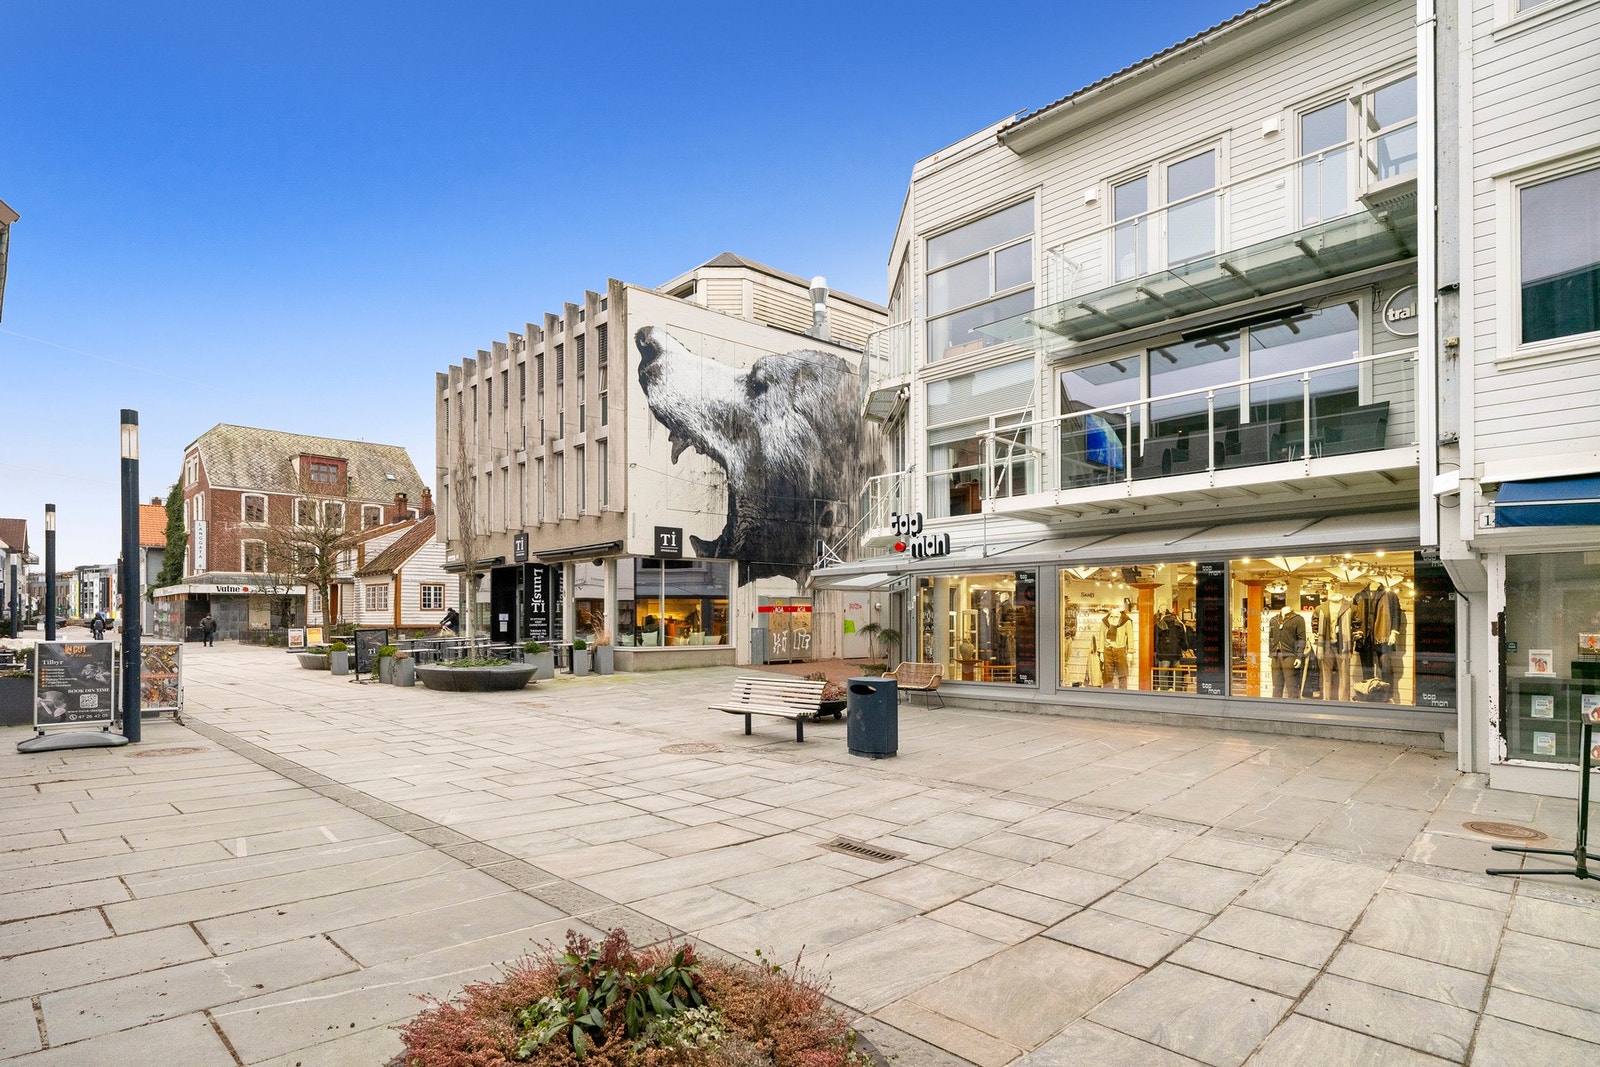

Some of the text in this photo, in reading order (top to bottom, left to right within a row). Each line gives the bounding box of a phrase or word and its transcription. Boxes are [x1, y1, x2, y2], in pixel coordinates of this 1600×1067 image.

[890, 512, 922, 538] top
[660, 531, 677, 547] Ti
[910, 532, 950, 558] man
[216, 585, 241, 593] Vatne
[531, 568, 544, 603] Lunsj
